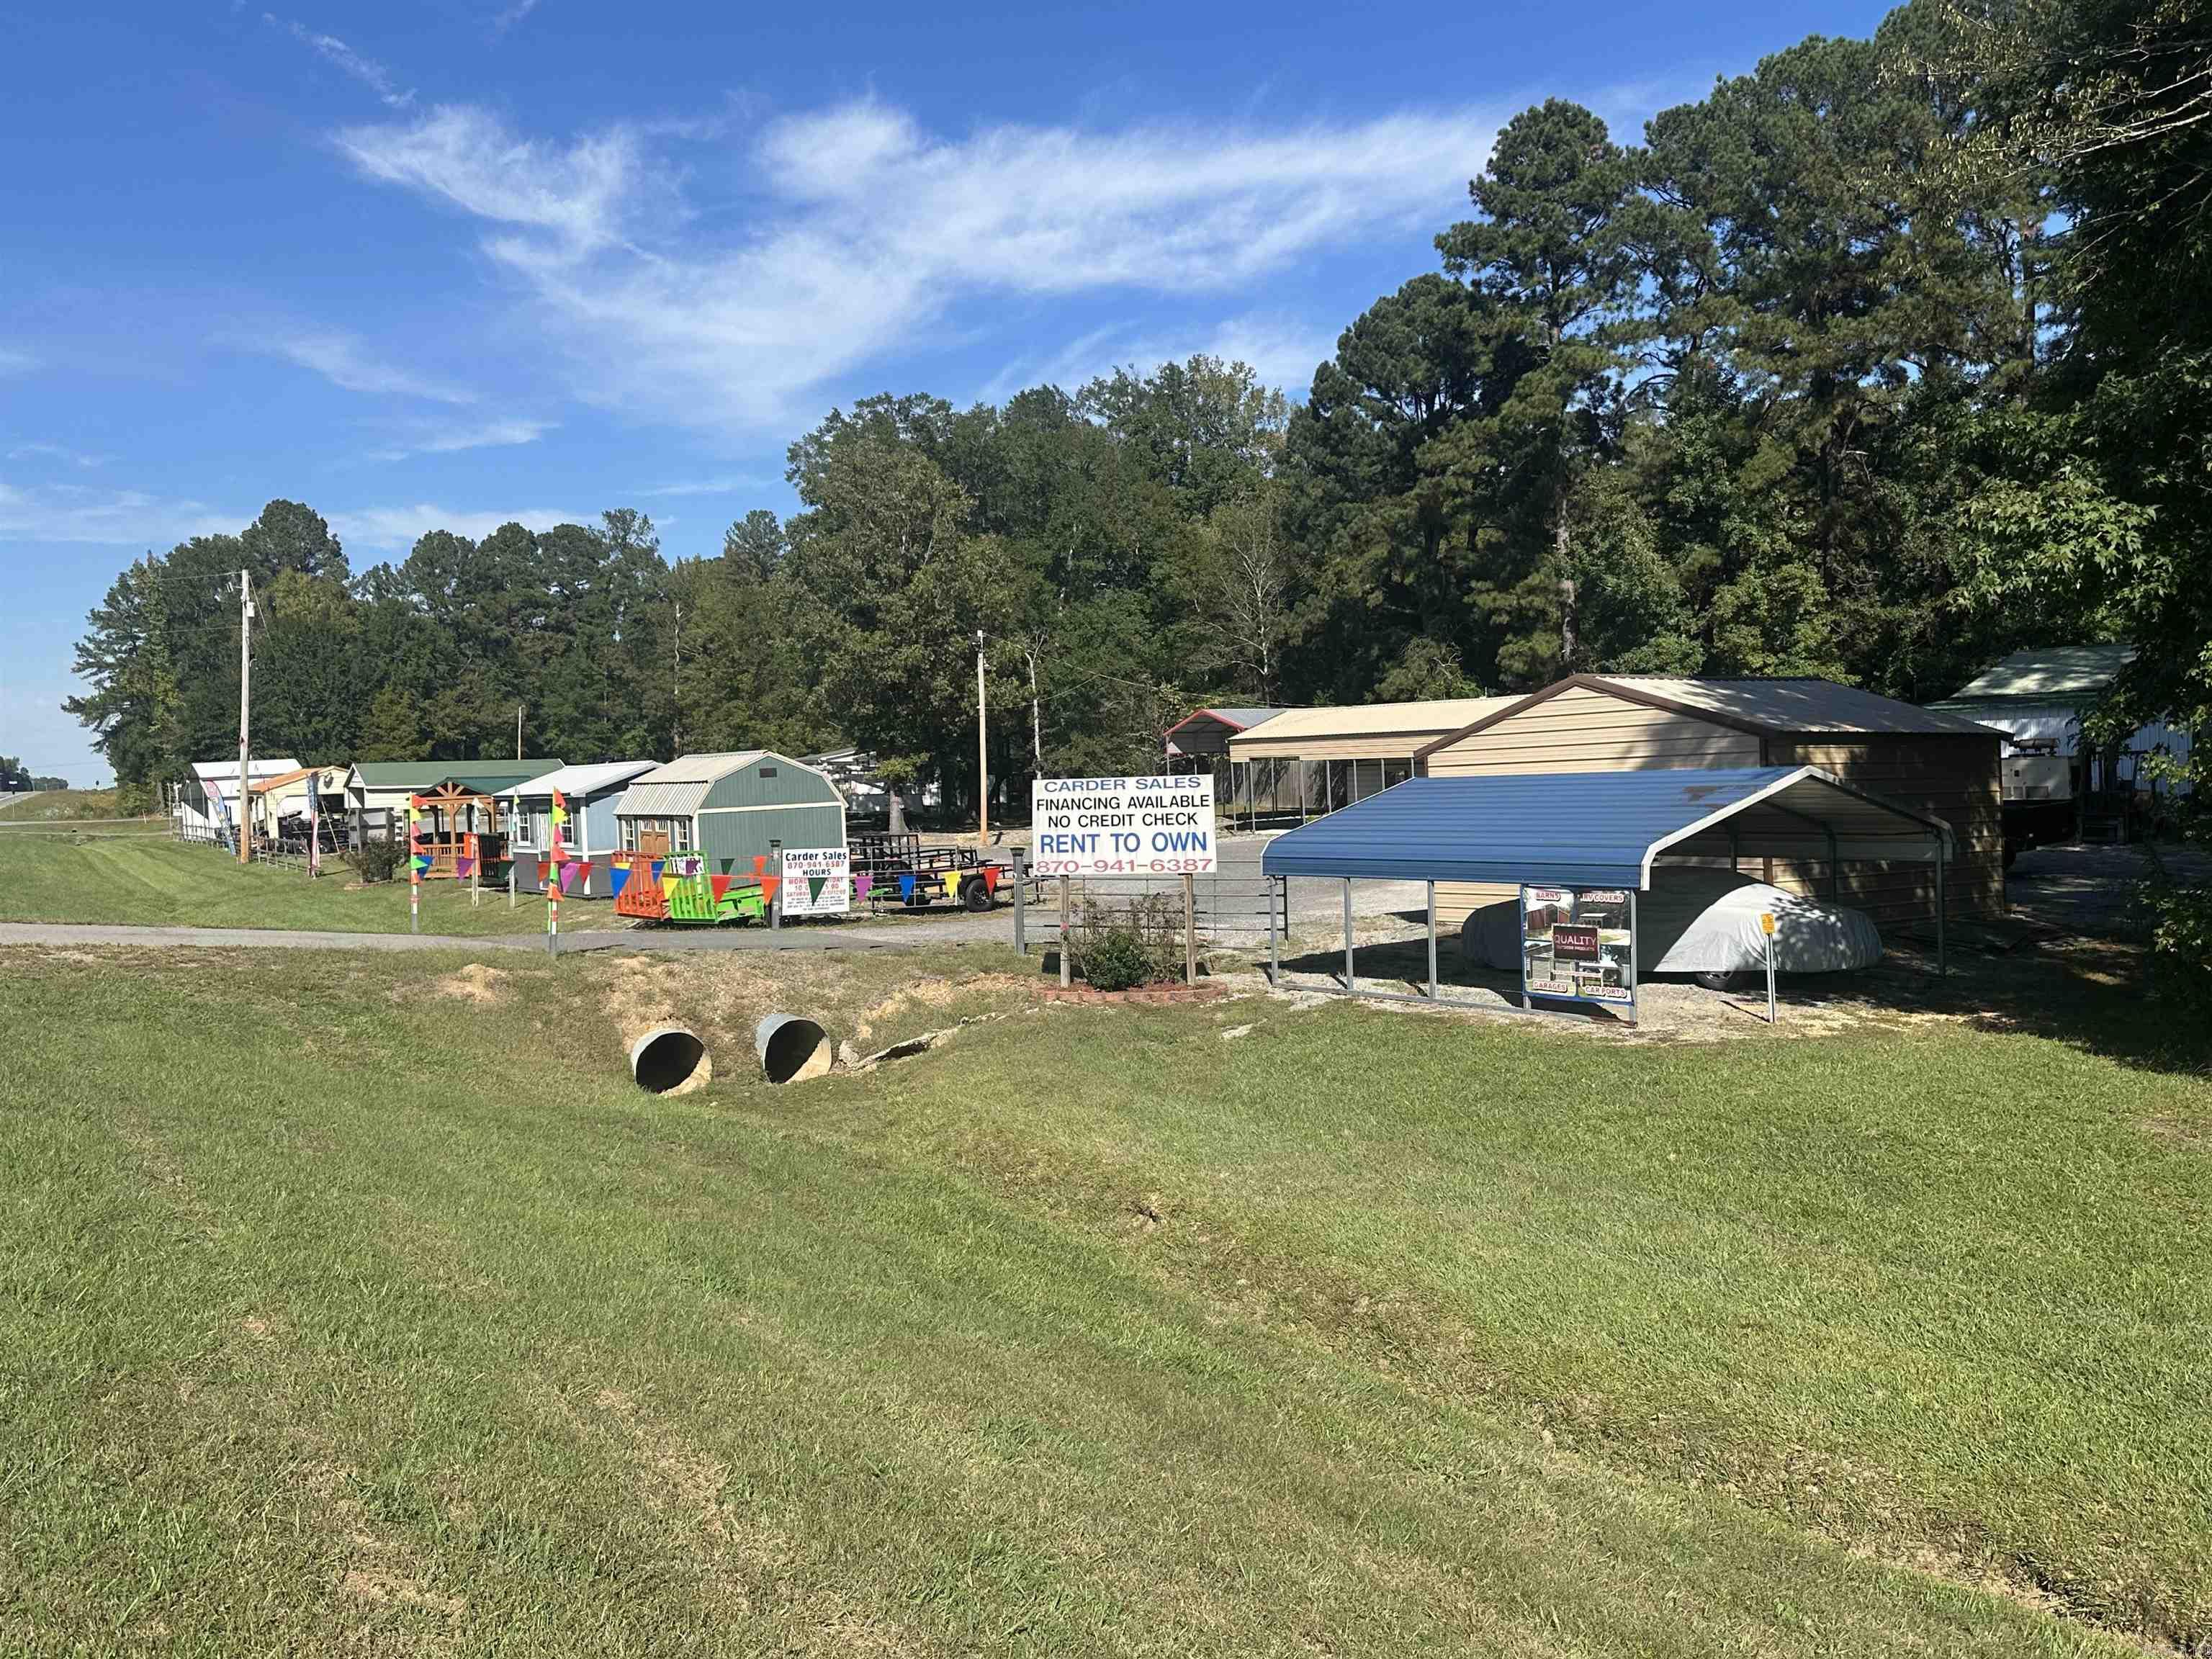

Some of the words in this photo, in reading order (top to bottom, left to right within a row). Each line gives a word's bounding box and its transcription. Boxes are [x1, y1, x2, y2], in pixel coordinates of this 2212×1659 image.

[1044, 779, 1126, 792] CARDER
[1136, 777, 1201, 789] SALES
[1037, 796, 1120, 811] FINANCING
[1128, 795, 1210, 809] AVAILABLE
[1048, 815, 1071, 828] NO
[1078, 814, 1135, 827] CREDIT
[1142, 812, 1198, 826] CHECK
[1040, 834, 1100, 853] RENT
[1110, 832, 1141, 853] TO
[1152, 832, 1207, 852] OWN
[786, 852, 819, 861] Carder
[822, 851, 847, 860] Sales
[1036, 858, 1213, 873] 870-941-6387
[1555, 935, 1596, 945] QUALITY
[1534, 981, 1566, 991] GARAGES
